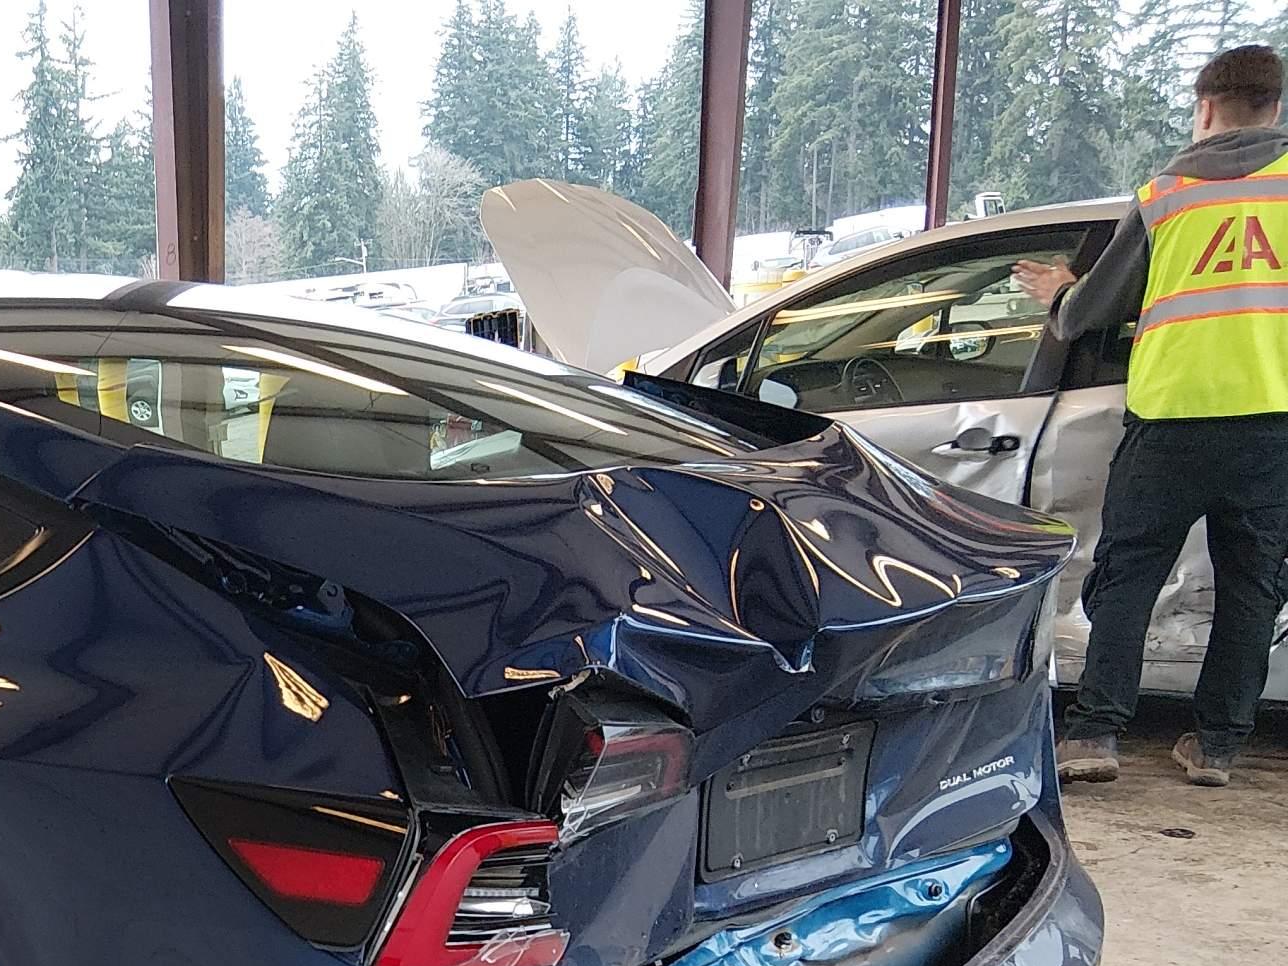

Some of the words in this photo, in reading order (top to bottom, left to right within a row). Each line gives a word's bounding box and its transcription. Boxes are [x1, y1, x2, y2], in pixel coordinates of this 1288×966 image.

[167, 242, 177, 266] 8
[939, 773, 972, 790] DUAL
[972, 755, 1015, 779] MOTOR
